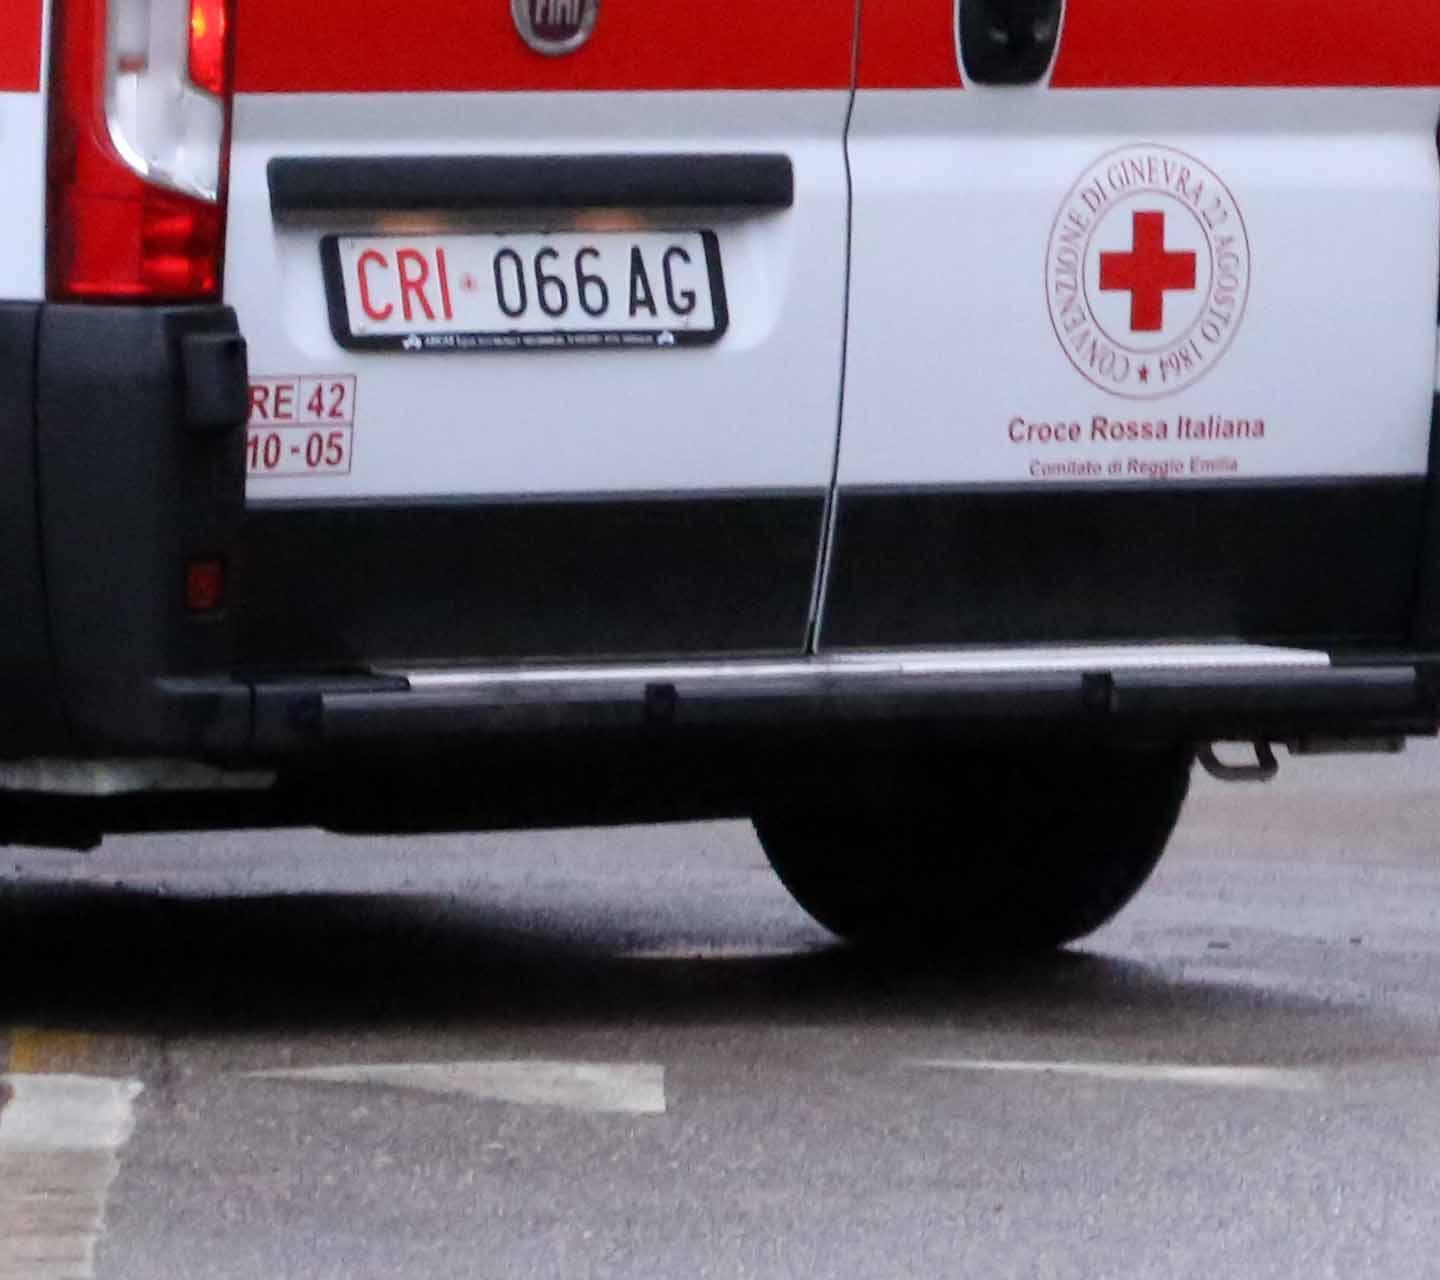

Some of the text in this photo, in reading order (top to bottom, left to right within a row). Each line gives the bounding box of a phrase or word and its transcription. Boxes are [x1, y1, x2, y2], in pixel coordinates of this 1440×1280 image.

[1080, 177, 1109, 215] DI
[1106, 156, 1205, 207] GINEVRA
[357, 244, 697, 322] CRI 066 AG
[1054, 207, 1131, 384] CONVENZIONE
[1202, 233, 1241, 345] AGOSTO
[1158, 339, 1204, 383] 1864
[246, 382, 346, 420] RE 42
[1007, 413, 1266, 443] Croce Rossa Italiana
[1028, 455, 1239, 480] Comitato di Reggio Emilia
